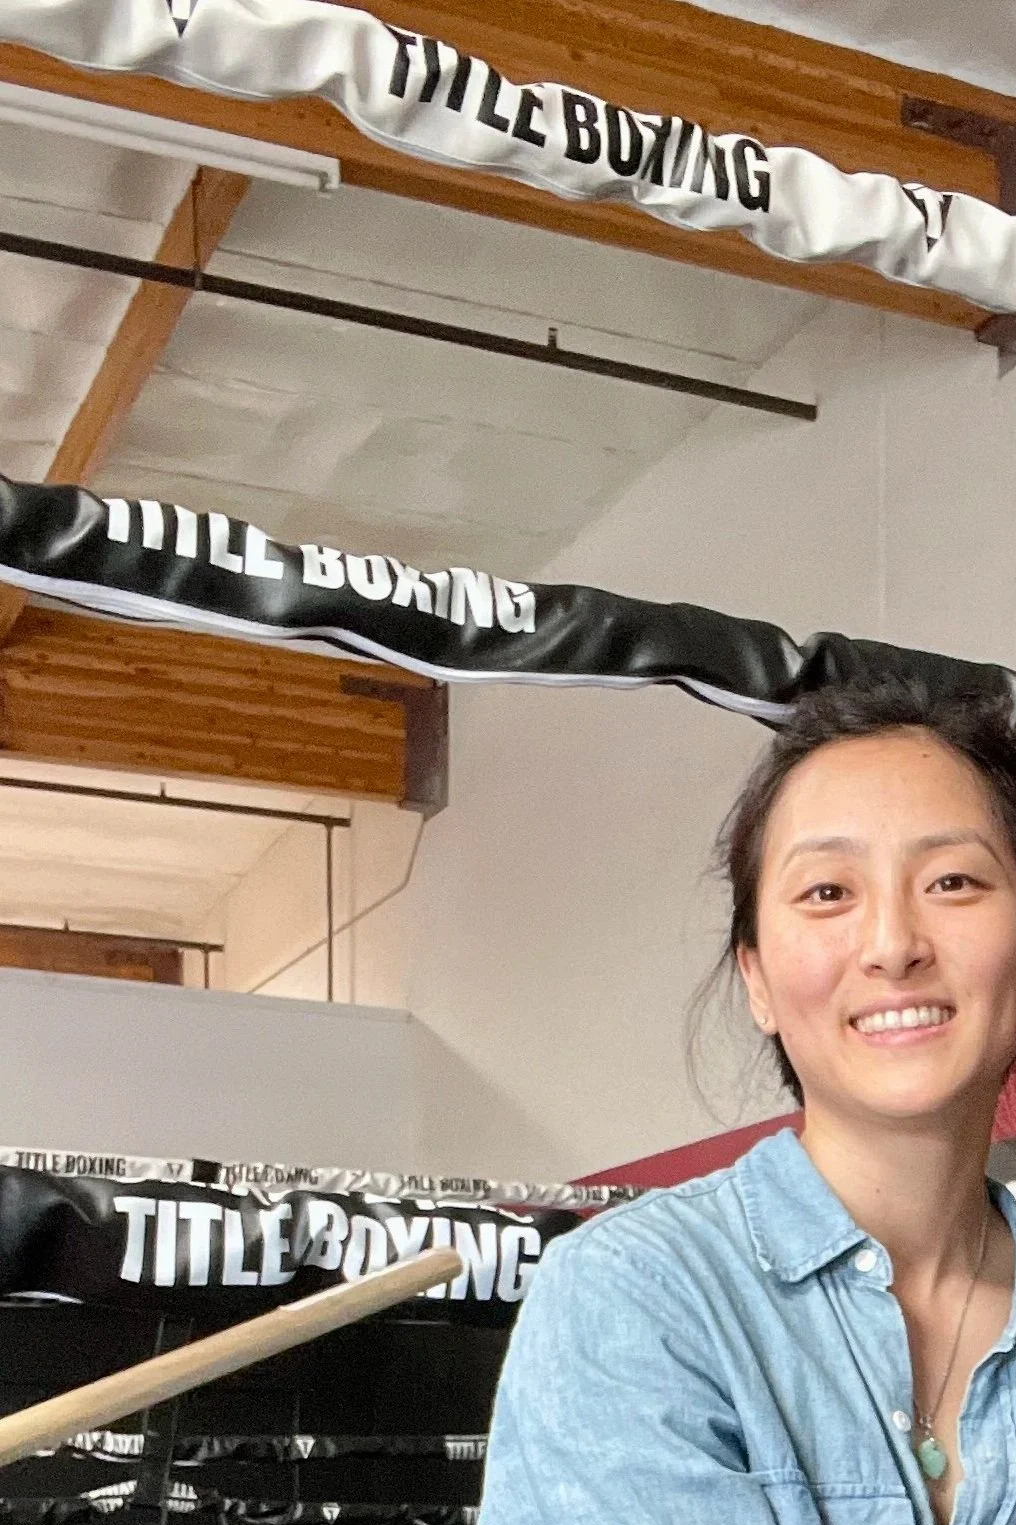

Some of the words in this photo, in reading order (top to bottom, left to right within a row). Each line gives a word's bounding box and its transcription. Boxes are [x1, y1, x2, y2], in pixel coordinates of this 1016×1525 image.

[383, 24, 548, 148] TITLE
[561, 89, 771, 213] BOXING
[101, 498, 284, 580] TITLE
[300, 543, 537, 634] BOXING
[15, 1151, 60, 1174] TITLE
[64, 1154, 127, 1177] BOXING
[114, 1195, 298, 1288] TITLE
[303, 1198, 543, 1303] BOXING
